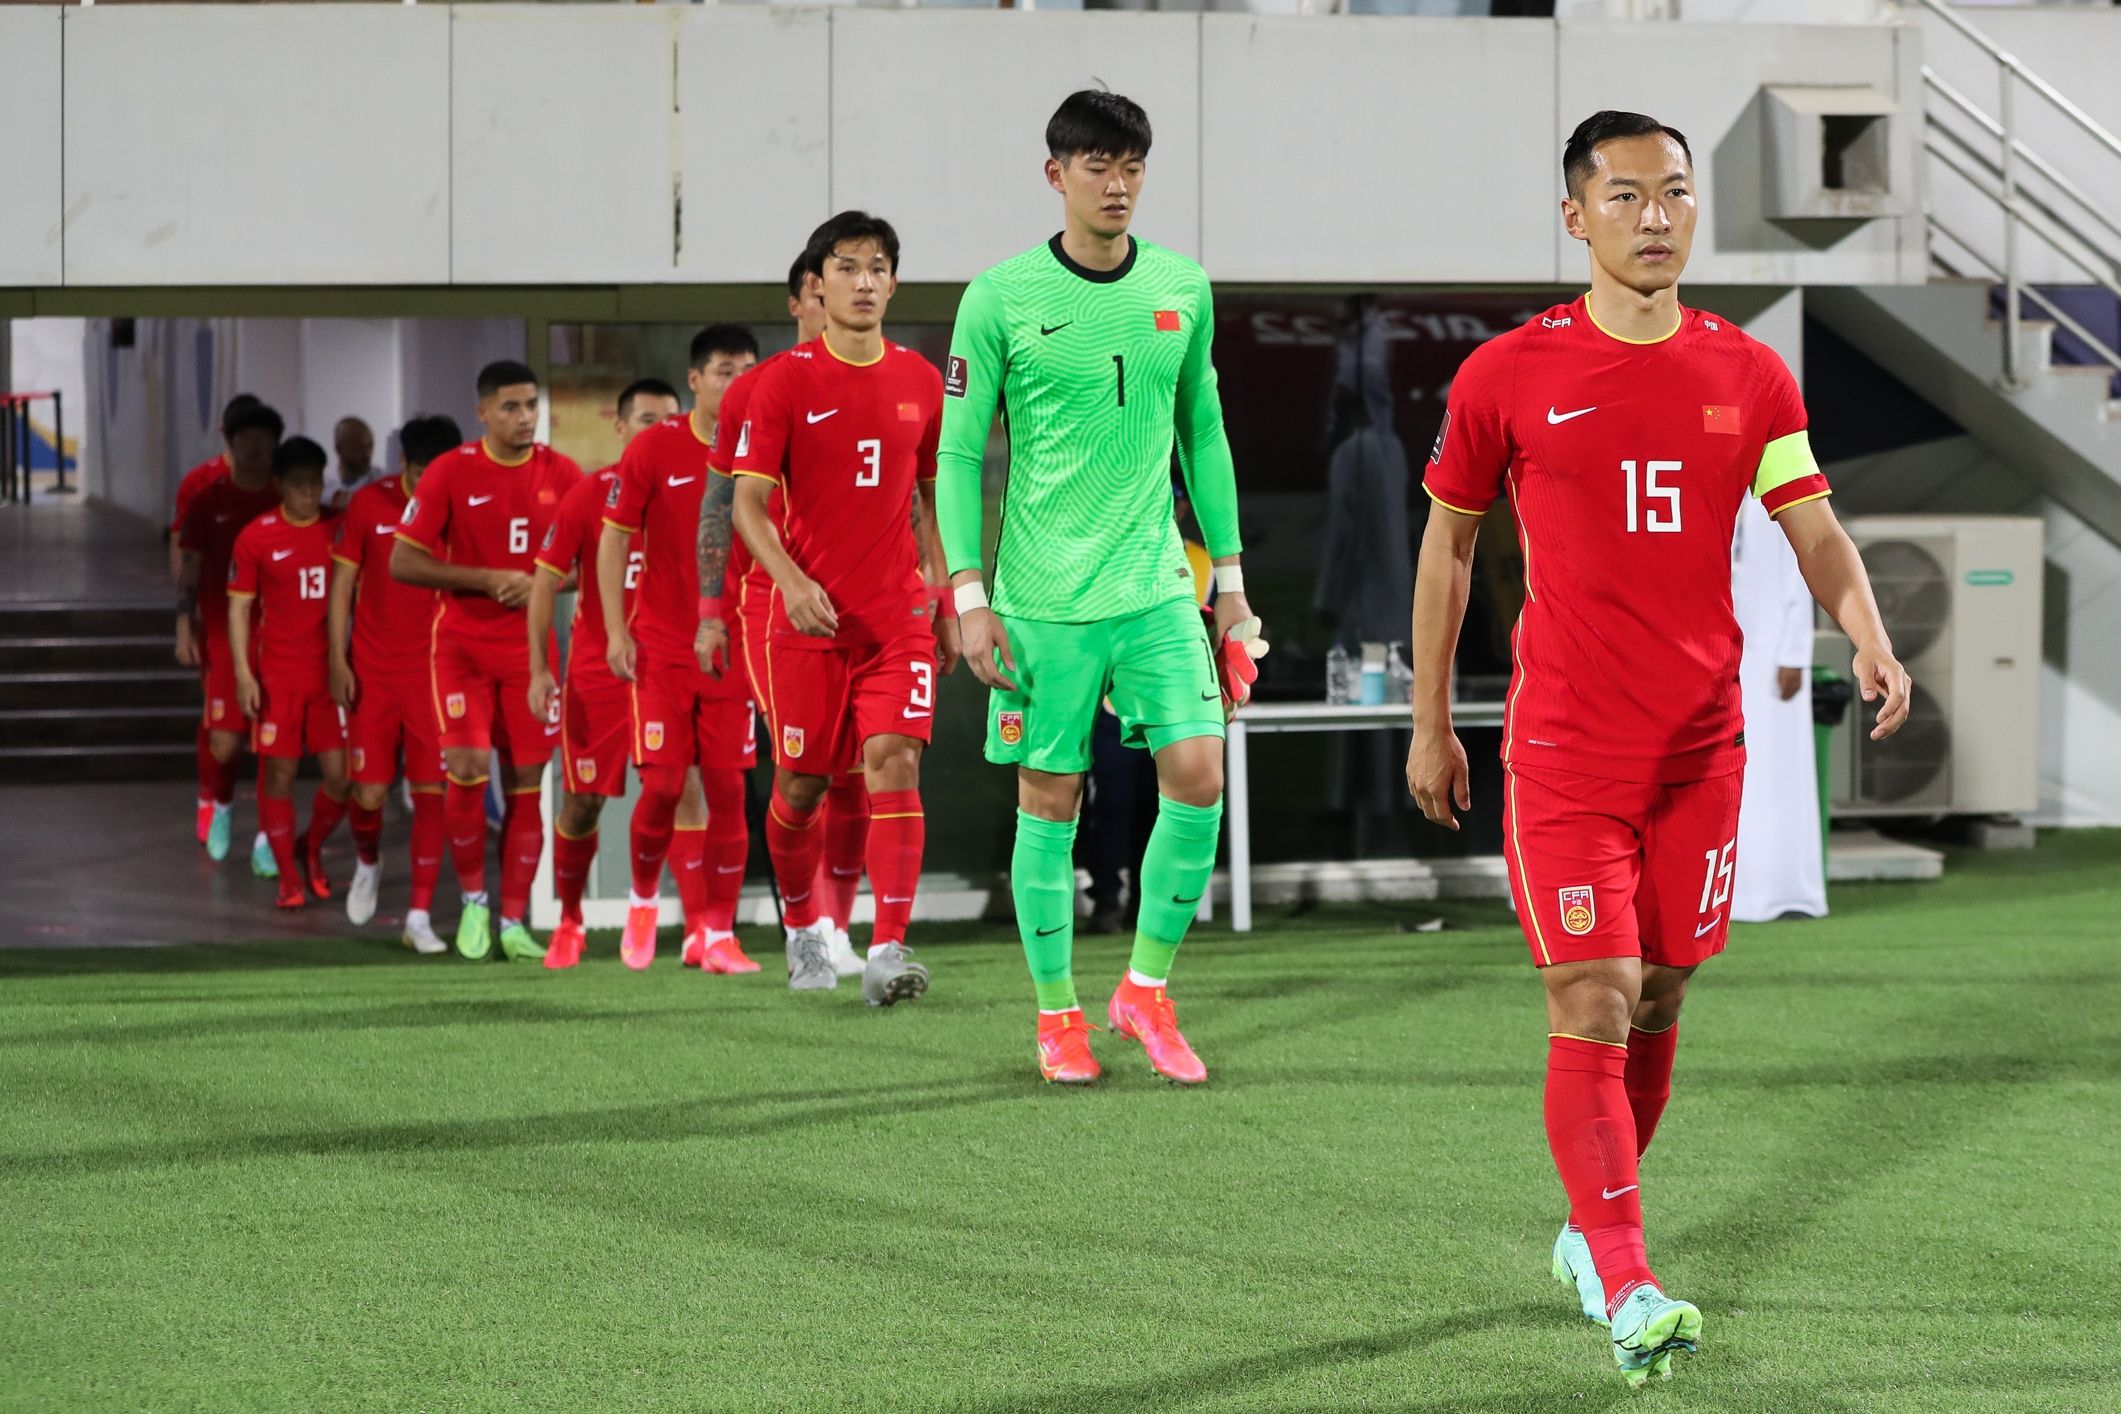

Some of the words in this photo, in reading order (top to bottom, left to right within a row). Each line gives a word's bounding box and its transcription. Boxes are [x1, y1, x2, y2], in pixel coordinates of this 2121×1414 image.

[1541, 316, 1571, 329] CFA
[1112, 355, 1126, 407] 1
[855, 438, 882, 488] 3
[1620, 459, 1683, 533] 15
[508, 517, 529, 555] 6
[298, 565, 326, 600] 13
[909, 660, 932, 709] 3
[1563, 890, 1590, 901] CFA
[1698, 835, 1736, 914] 15
